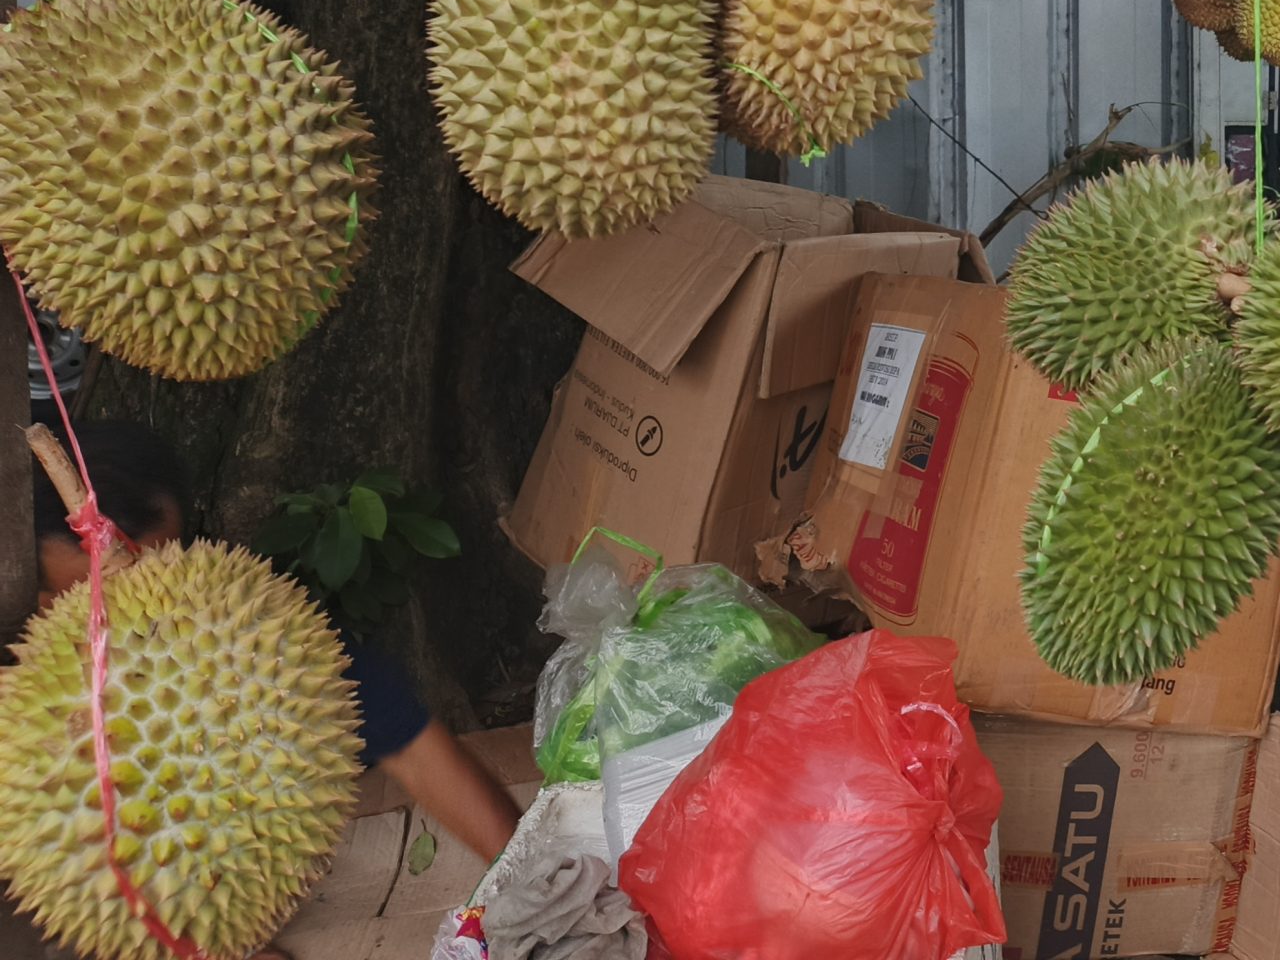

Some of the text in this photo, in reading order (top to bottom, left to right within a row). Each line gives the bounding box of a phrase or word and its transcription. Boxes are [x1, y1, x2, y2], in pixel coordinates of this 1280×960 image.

[1130, 730, 1150, 779] 9.600
[1149, 744, 1165, 765] 12
[1053, 783, 1105, 932] SATU
